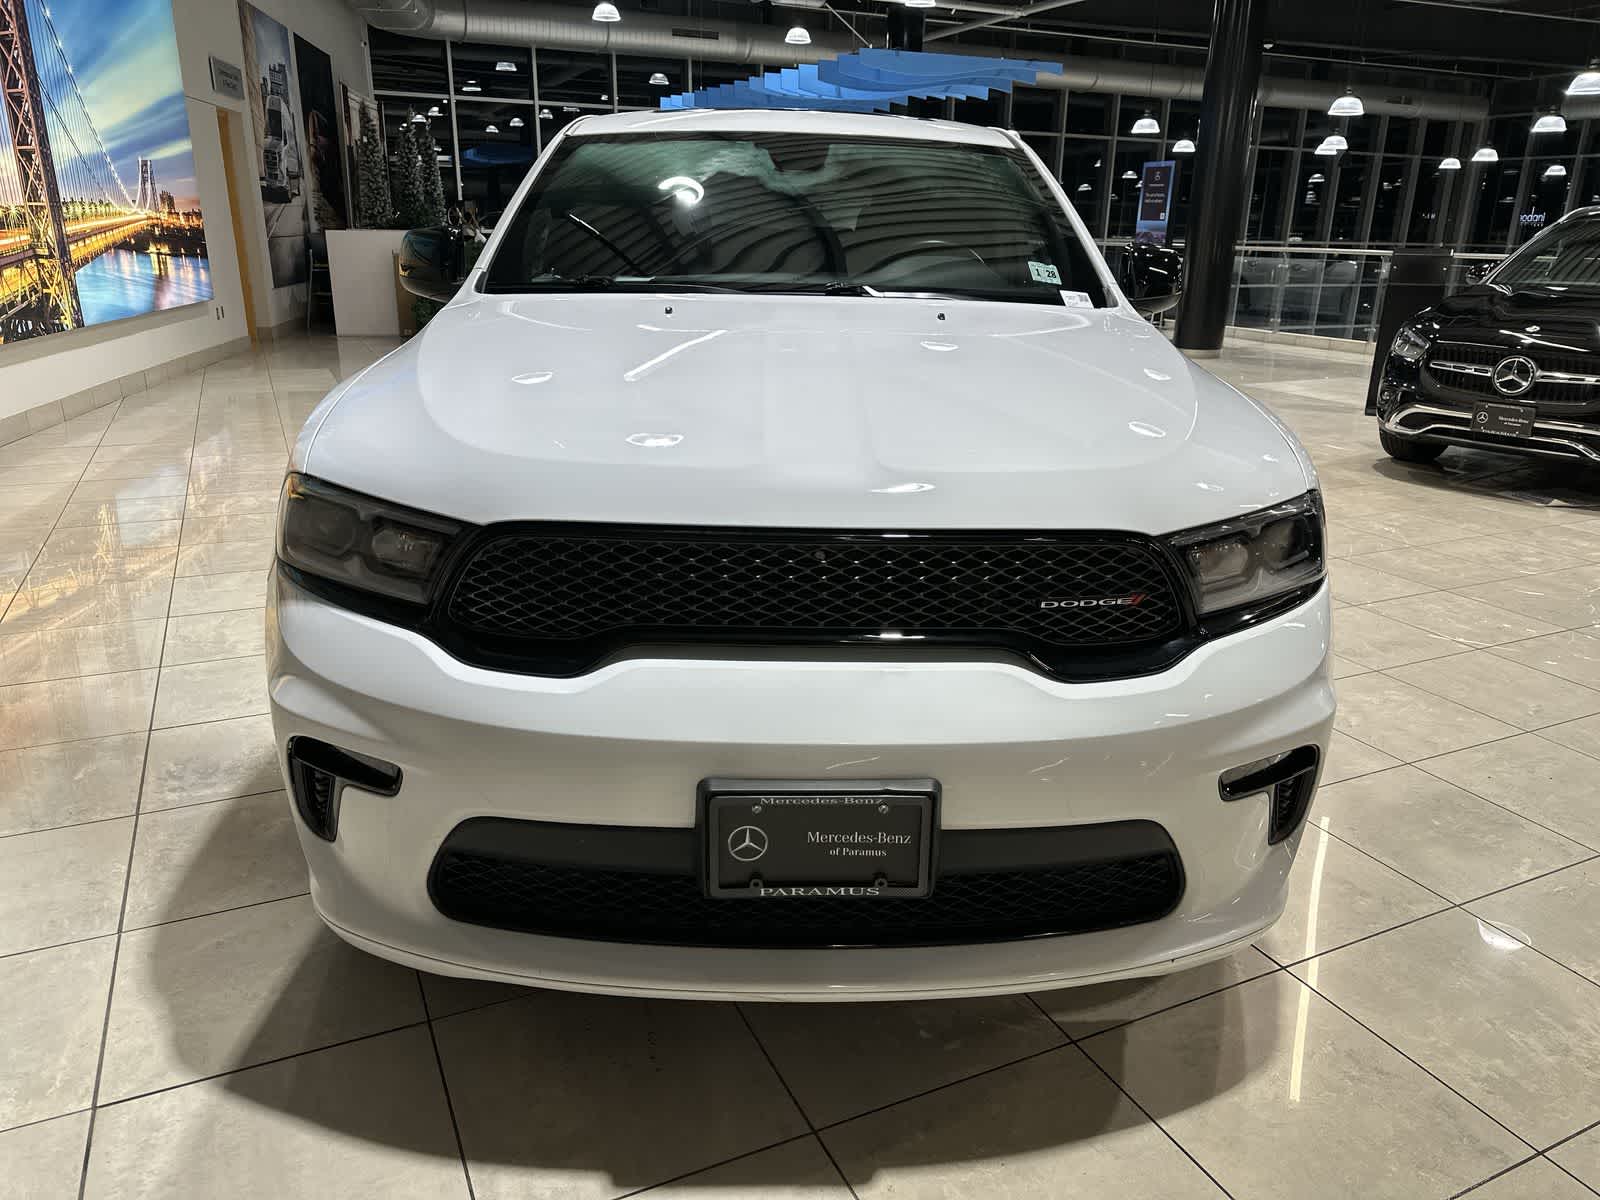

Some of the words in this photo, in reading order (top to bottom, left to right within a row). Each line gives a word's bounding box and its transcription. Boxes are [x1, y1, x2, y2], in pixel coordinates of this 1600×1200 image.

[1046, 270, 1056, 278] 28
[1040, 597, 1132, 609] DODGE
[760, 797, 883, 805] Mercedes-Benz
[807, 831, 912, 844] Mercedes-Benz
[829, 848, 840, 856] of
[842, 848, 887, 857] Paramus
[760, 887, 880, 896] PARAMUS
